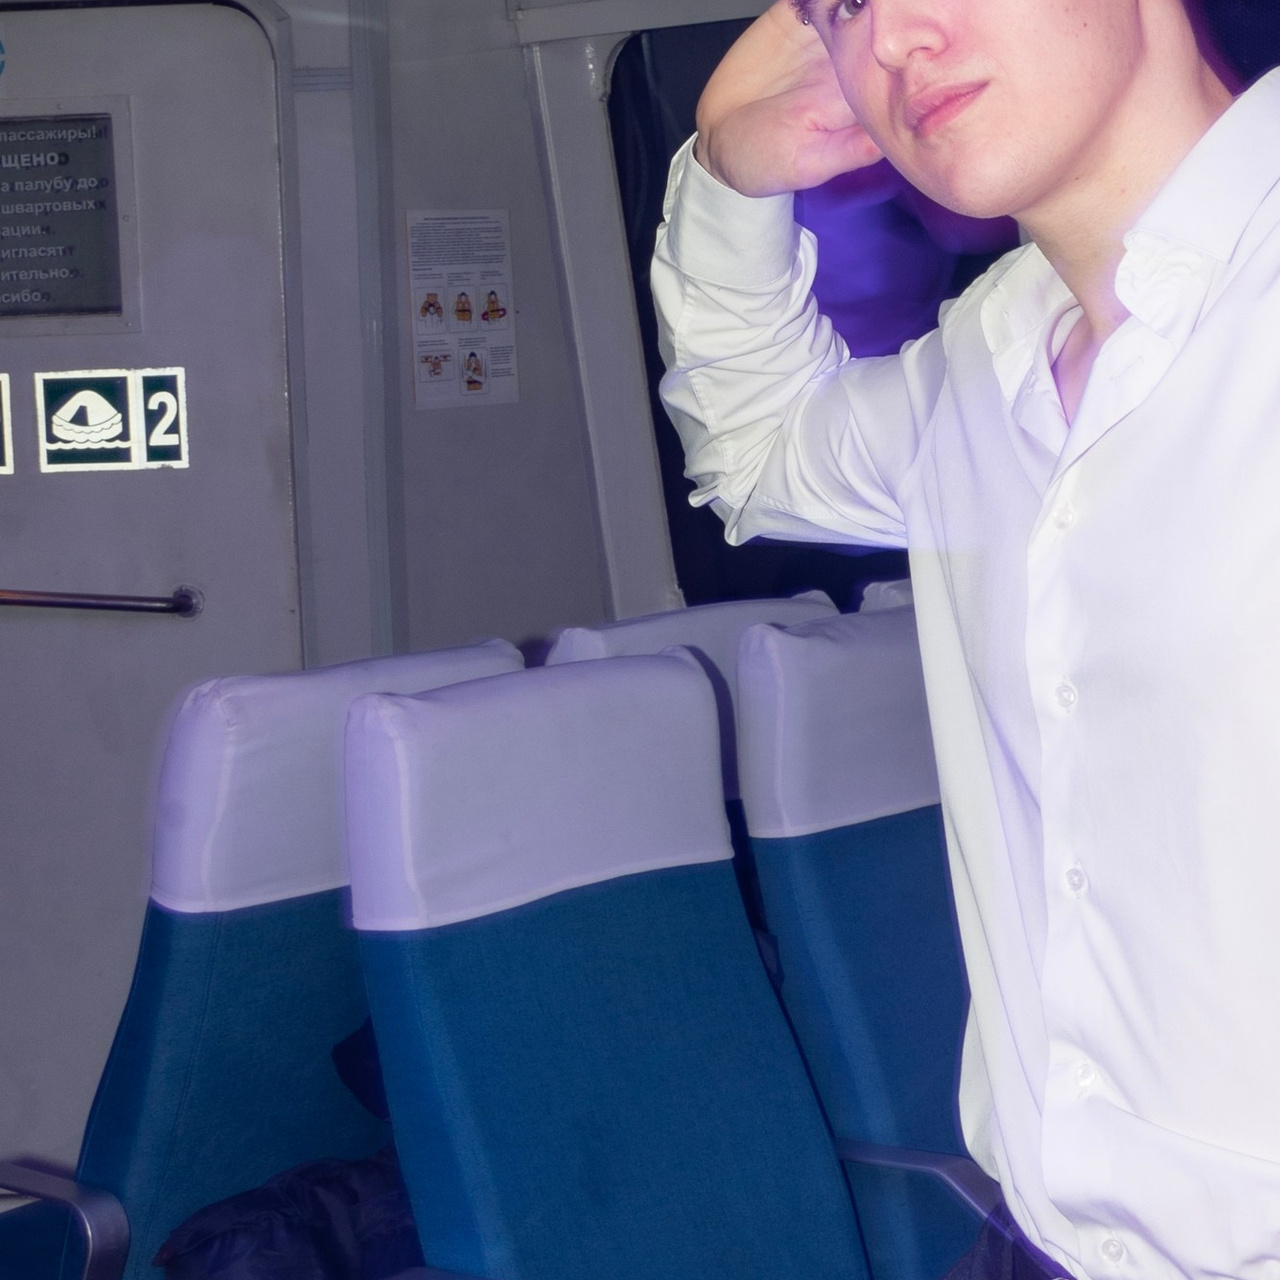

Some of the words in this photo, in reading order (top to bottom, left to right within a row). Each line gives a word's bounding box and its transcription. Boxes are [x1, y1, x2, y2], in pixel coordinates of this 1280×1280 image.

[15, 176, 73, 194] палубу
[76, 177, 98, 190] до
[1, 199, 96, 216] швартовых
[147, 391, 180, 447] 2
